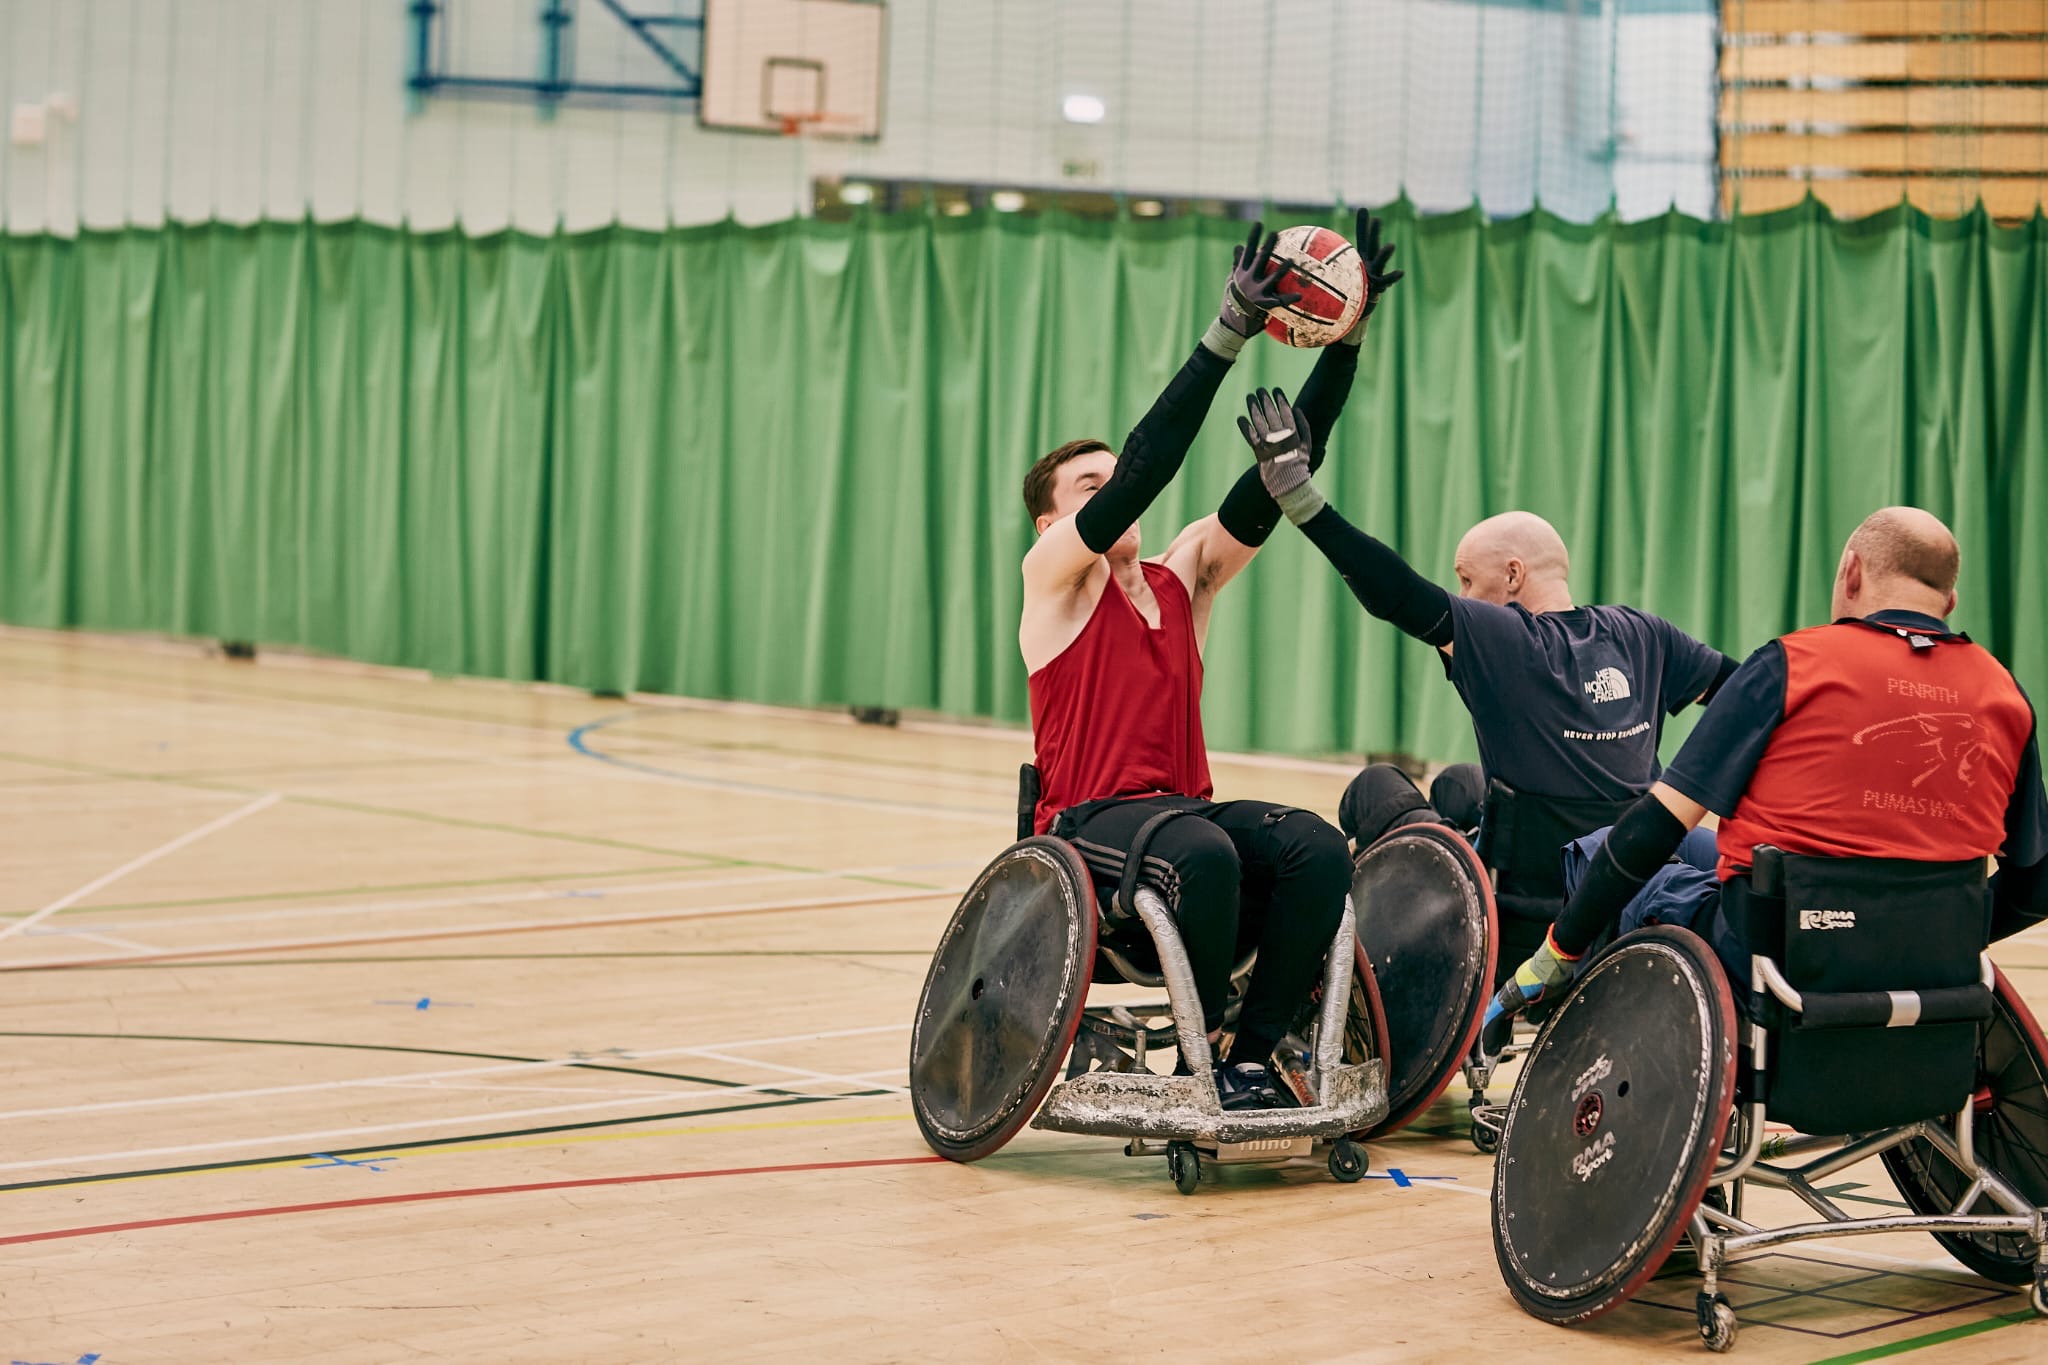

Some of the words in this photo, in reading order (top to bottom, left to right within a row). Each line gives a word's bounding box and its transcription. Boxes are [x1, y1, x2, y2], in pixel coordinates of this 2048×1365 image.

[1887, 677, 1960, 705] PENRITH
[1563, 729, 1594, 741] NEVER
[1596, 731, 1617, 741] STOP
[1862, 789, 1927, 815] PUMAS
[1822, 910, 1856, 920] RMA
[1572, 1131, 1617, 1174] RMA
[1577, 1148, 1614, 1182] Sport
